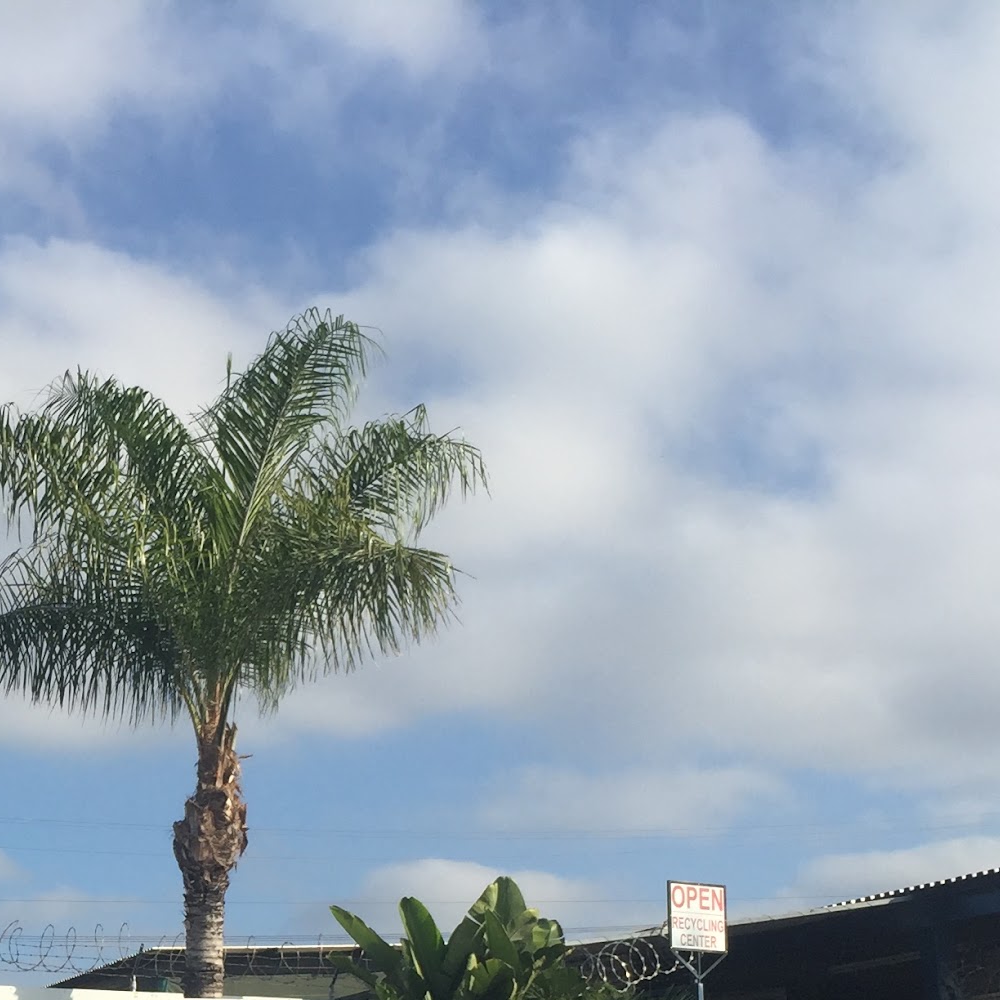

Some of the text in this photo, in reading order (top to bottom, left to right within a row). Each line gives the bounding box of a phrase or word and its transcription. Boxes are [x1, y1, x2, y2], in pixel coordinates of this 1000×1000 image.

[671, 885, 724, 911] OPEN
[671, 916, 724, 933] RECYCLING
[680, 933, 717, 949] CENTER
